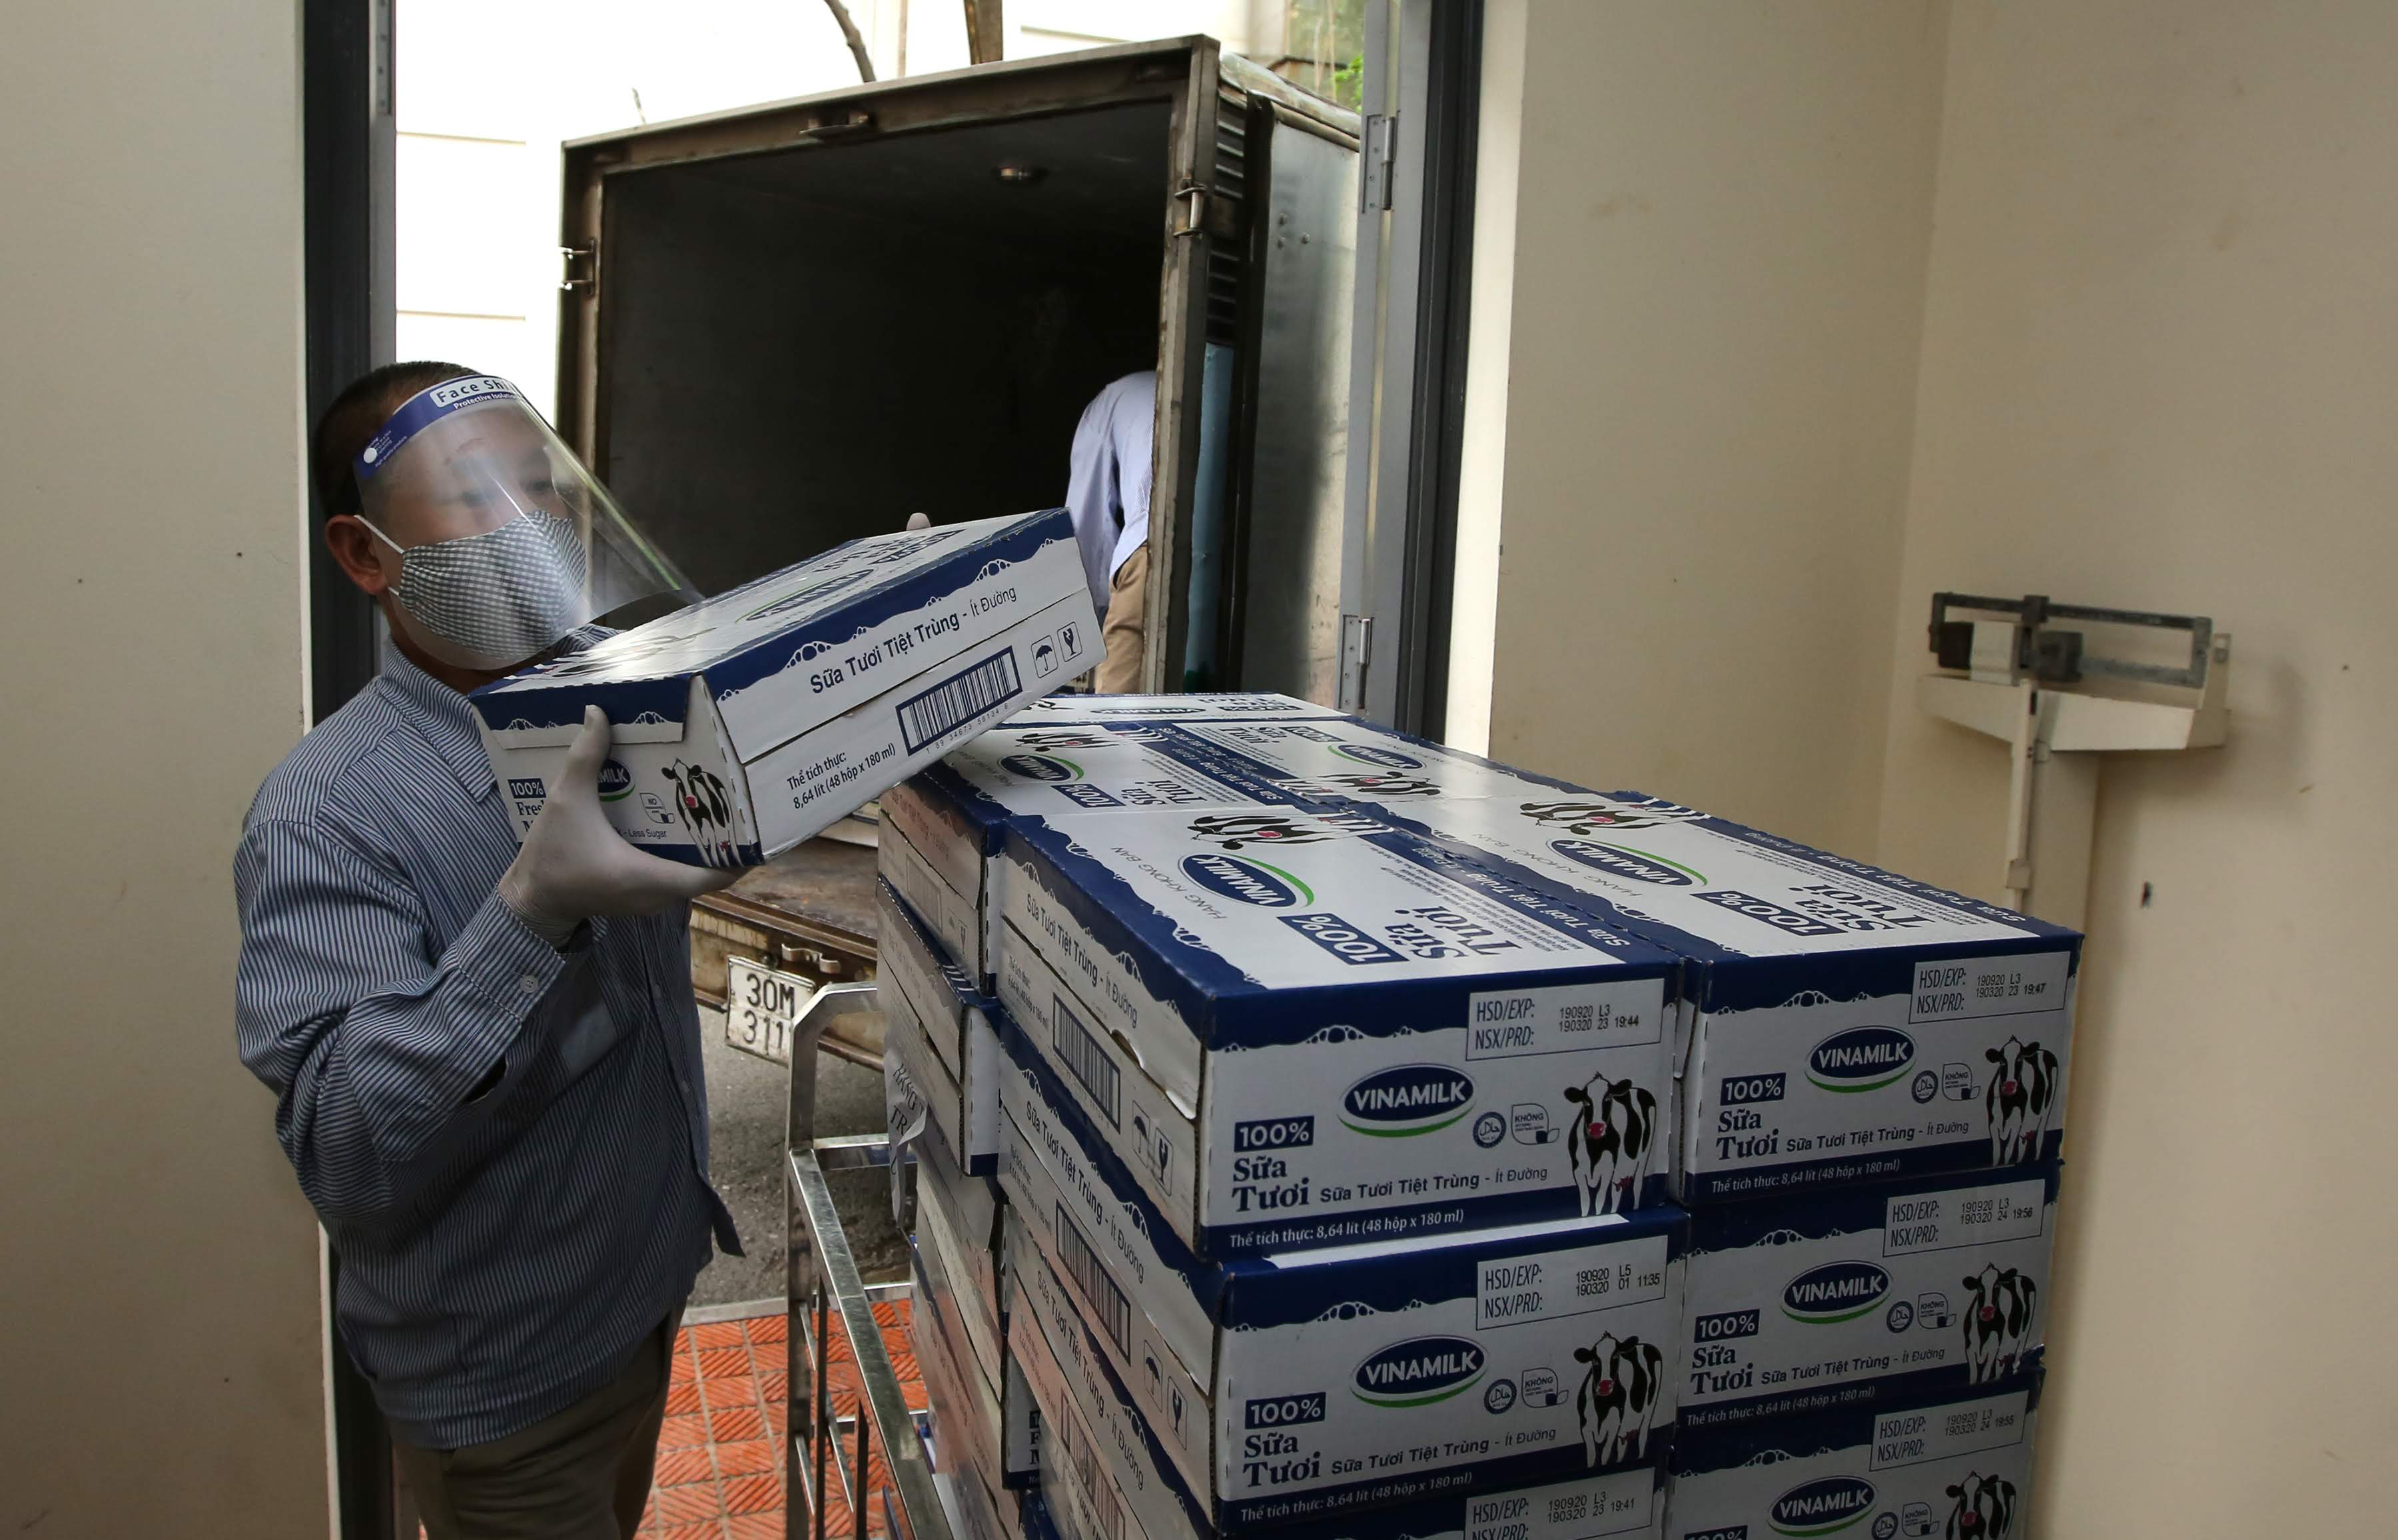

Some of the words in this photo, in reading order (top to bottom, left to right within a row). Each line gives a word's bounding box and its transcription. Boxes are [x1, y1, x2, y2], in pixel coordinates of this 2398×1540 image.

[436, 384, 480, 402] Face
[454, 394, 491, 410] Protective
[810, 667, 844, 693] Sữa
[845, 645, 882, 676] Tươi
[883, 631, 914, 657] Tiệt
[914, 613, 960, 643] Trùng
[970, 599, 979, 617] Ít
[981, 587, 1016, 612] Đường
[599, 768, 629, 783] MILK
[787, 770, 805, 791] Thể
[806, 761, 823, 779] tích
[824, 752, 847, 771] thực:
[793, 789, 815, 809] 8,64
[815, 783, 825, 798] lít
[825, 776, 841, 794] (48
[841, 767, 858, 786] hộp
[865, 752, 881, 769] 180
[881, 742, 896, 763] ml)
[511, 782, 544, 797] 100%
[1062, 784, 1116, 807] 100%
[516, 800, 545, 816] Fre
[645, 829, 667, 839] Sugar
[1557, 842, 1680, 883] VINAMILK
[1192, 856, 1286, 905] VINAMILK
[1706, 893, 1829, 934] 100%
[1789, 884, 1935, 928] Tươi
[1795, 899, 1894, 931] Sữa
[1292, 915, 1392, 962] 100%
[1385, 923, 1469, 959] Sữa
[1394, 906, 1523, 955] Tươi
[1040, 908, 1056, 939] Tươi
[1058, 924, 1072, 956] Tiệt
[1074, 941, 1098, 988] Trùng
[1112, 983, 1137, 1028] Đường
[1920, 967, 1966, 988] HSD/EXP:
[1977, 974, 2005, 986] 190920
[2010, 973, 2020, 984] L3
[747, 973, 795, 1018] 30M
[1477, 998, 1535, 1022] HSD/EXP:
[1559, 1006, 1593, 1019] 190920
[1599, 1004, 1610, 1017] L3
[1917, 992, 1964, 1014] NSX/PRD:
[1976, 986, 2003, 998] 190320
[2008, 985, 2018, 996] 23
[2024, 982, 2046, 995] 19:47
[743, 1010, 784, 1056] 311
[1475, 1026, 1534, 1050] NSX/PRD:
[1559, 1019, 1592, 1032] 190320
[1597, 1018, 1609, 1030] 23
[1615, 1015, 1639, 1028] 19:44
[1818, 1042, 1908, 1069] VINAMILK
[1726, 1078, 1781, 1100] 100%
[1946, 1071, 1968, 1080] KHÔNG
[1354, 1080, 1466, 1110] VINAMILK
[1515, 1112, 1544, 1122] KHÔNG
[1718, 1108, 1761, 1132] Sữa
[1240, 1122, 1309, 1147] 100%
[1716, 1128, 1779, 1160] Tươi
[1787, 1138, 1812, 1152] Sữa
[1816, 1134, 1845, 1149] Tươi
[1850, 1131, 1873, 1147] Tiệt
[1877, 1127, 1915, 1141] Trùng
[1927, 1122, 1933, 1136] Ít
[1936, 1122, 1969, 1134] Đường
[1233, 1156, 1287, 1182] Sữa
[1232, 1177, 1310, 1212] Tươi
[1320, 1186, 1351, 1202] Sữa
[1358, 1182, 1392, 1198] Tươi
[1398, 1178, 1427, 1195] Tiệt
[1433, 1174, 1479, 1190] Trùng
[1495, 1167, 1503, 1183] Ít
[1507, 1168, 1548, 1181] Đường
[1892, 1200, 1939, 1223] HSD/EXP:
[1961, 1200, 1993, 1214] 190920
[1998, 1198, 2009, 1210] L3
[1231, 1232, 1252, 1247] Thể
[1256, 1229, 1279, 1245] tích
[1282, 1228, 1313, 1244] thực:
[1316, 1223, 1342, 1239] 8,64
[1346, 1221, 1358, 1235] lít
[1362, 1219, 1381, 1235] (48
[1384, 1216, 1406, 1232] hộp
[1409, 1219, 1416, 1228] x
[1421, 1212, 1441, 1226] 180
[1444, 1209, 1463, 1224] ml)
[1890, 1224, 1938, 1247] NSX/PRD:
[1960, 1212, 1992, 1225] 190320
[1998, 1210, 2008, 1222] 24
[2013, 1207, 2033, 1219] 19:56
[1485, 1264, 1542, 1291] HSD/EXP:
[1576, 1268, 1609, 1284] 190920
[1619, 1264, 1631, 1277] L5
[1792, 1274, 1883, 1304] VINAMILK
[1485, 1292, 1543, 1318] NSX/PRD:
[1575, 1280, 1609, 1297] 190320
[1619, 1278, 1629, 1290] 01
[1637, 1273, 1660, 1287] 11:35
[1920, 1300, 1944, 1310] KHÔNG
[1699, 1314, 1756, 1339] 100%
[1366, 1349, 1477, 1385] VINAMILK
[1691, 1344, 1737, 1369] Sữa
[1761, 1370, 1787, 1385] Sữa
[1792, 1364, 1820, 1380] Tươi
[1824, 1360, 1848, 1376] Tiệt
[1853, 1354, 1890, 1371] Trùng
[1902, 1349, 1909, 1363] Ít
[1912, 1349, 1945, 1361] Đường
[1524, 1375, 1553, 1388] KHÔNG
[1690, 1362, 1753, 1395] Tươi
[1251, 1397, 1321, 1424] 100%
[1880, 1415, 1927, 1439] HSD/EXP:
[1946, 1411, 1978, 1426] 190920
[1982, 1409, 1993, 1421] L3
[1244, 1431, 1299, 1458] Sữa
[1332, 1459, 1362, 1475] Sữa
[1368, 1451, 1403, 1469] Tươi
[1409, 1445, 1438, 1462] Tiệt
[1444, 1438, 1489, 1457] Trùng
[1505, 1432, 1512, 1446] Ít
[1516, 1428, 1556, 1445] Đường
[1877, 1439, 1924, 1462] NSX/PRD:
[1980, 1420, 1990, 1431] 24
[1242, 1451, 1320, 1487] Tươi
[1780, 1488, 1868, 1518] VINAMILK
